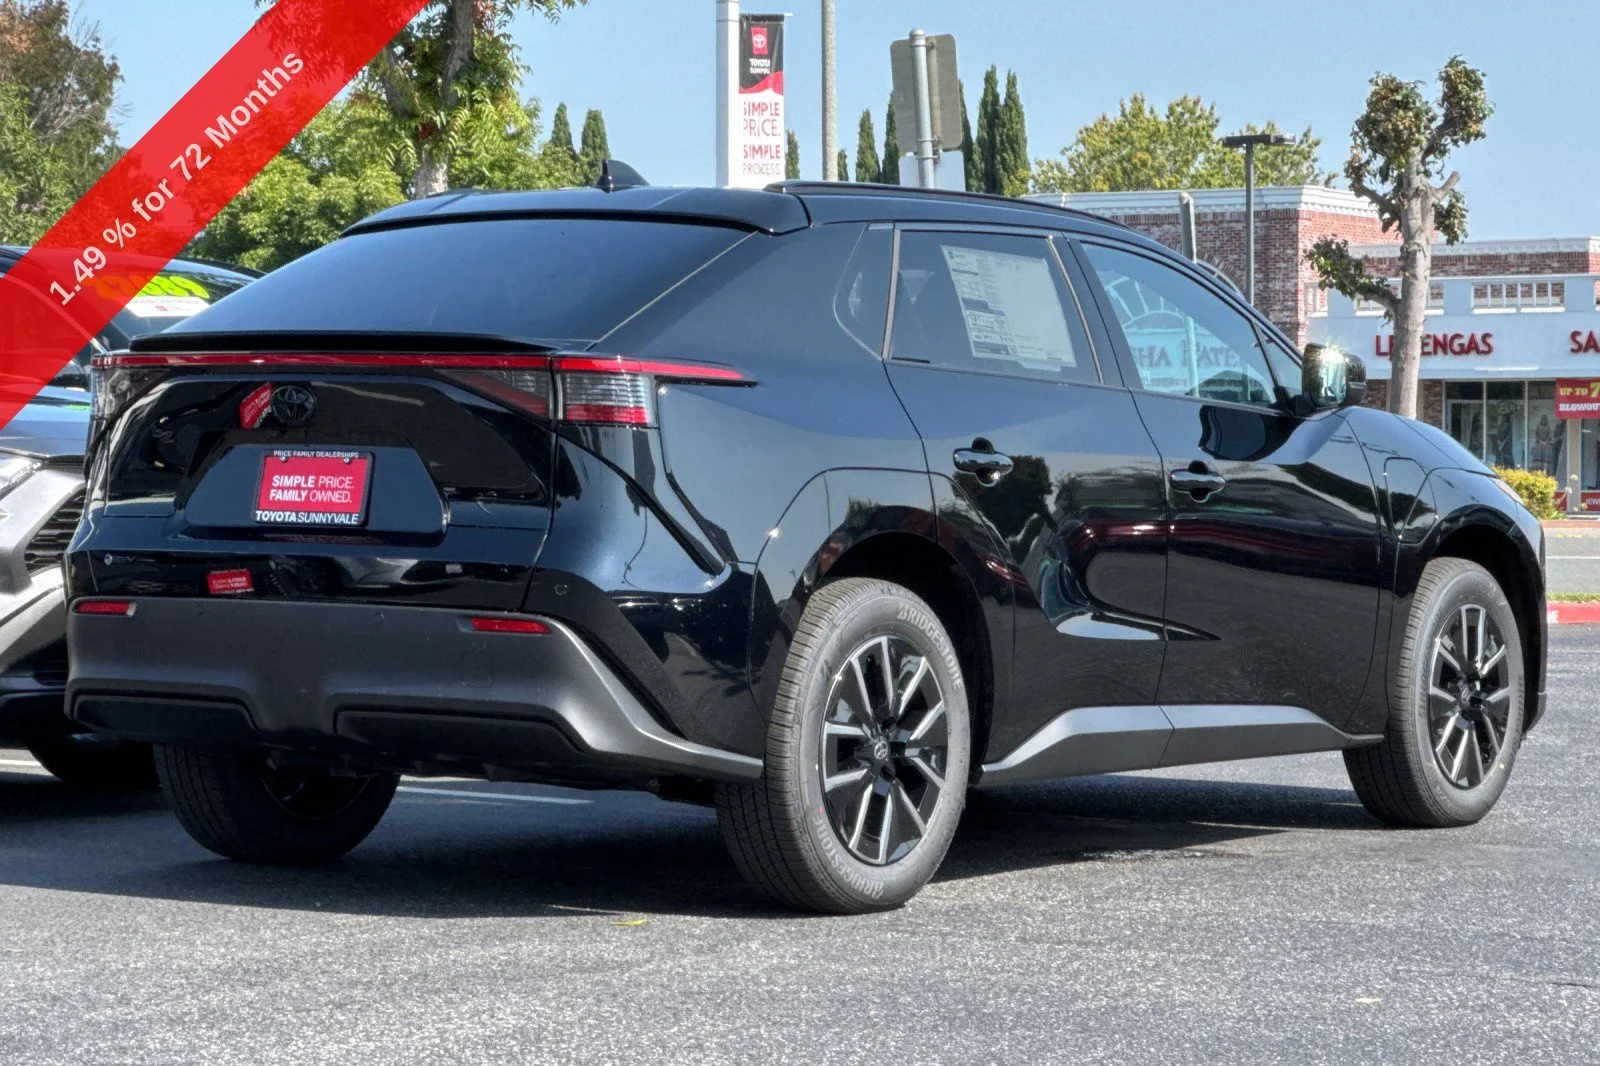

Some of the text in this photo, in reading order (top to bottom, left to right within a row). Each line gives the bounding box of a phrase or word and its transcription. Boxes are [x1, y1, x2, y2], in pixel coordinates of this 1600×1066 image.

[743, 102, 780, 116] SIMPLE
[743, 144, 780, 159] SIMPLE
[1375, 333, 1494, 356] LENGAS
[1559, 387, 1573, 396] UP
[1574, 387, 1588, 396] TO
[1559, 402, 1600, 412] BLOWOU
[293, 450, 314, 458] FAMILY
[271, 475, 354, 489] SIMPLE PRICE.
[269, 489, 352, 503] FAMILY OWNED.
[896, 602, 963, 691] BRIDGESTONE
